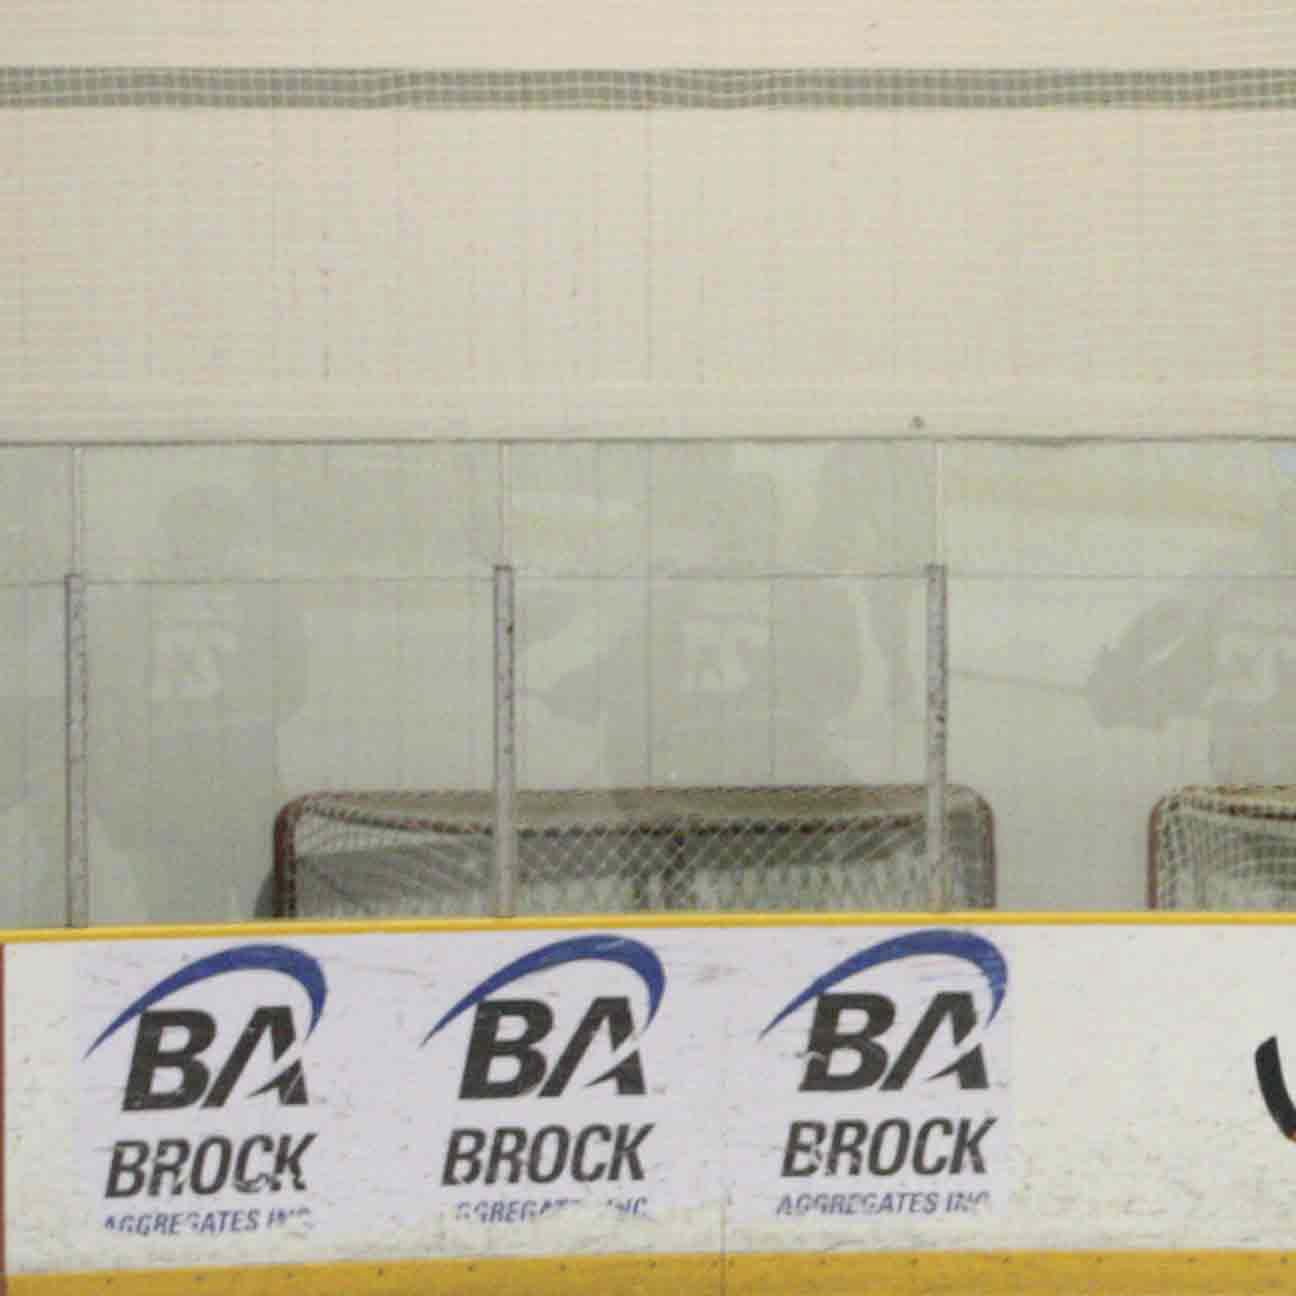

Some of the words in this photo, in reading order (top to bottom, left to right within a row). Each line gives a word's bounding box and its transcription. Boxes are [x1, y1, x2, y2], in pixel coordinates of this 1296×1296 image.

[121, 1005, 309, 1111] BA
[458, 995, 647, 1101] BA
[797, 991, 990, 1092] BA
[104, 1131, 318, 1199] BROCK
[440, 1122, 656, 1187] BROCK
[780, 1116, 998, 1178] BROCK
